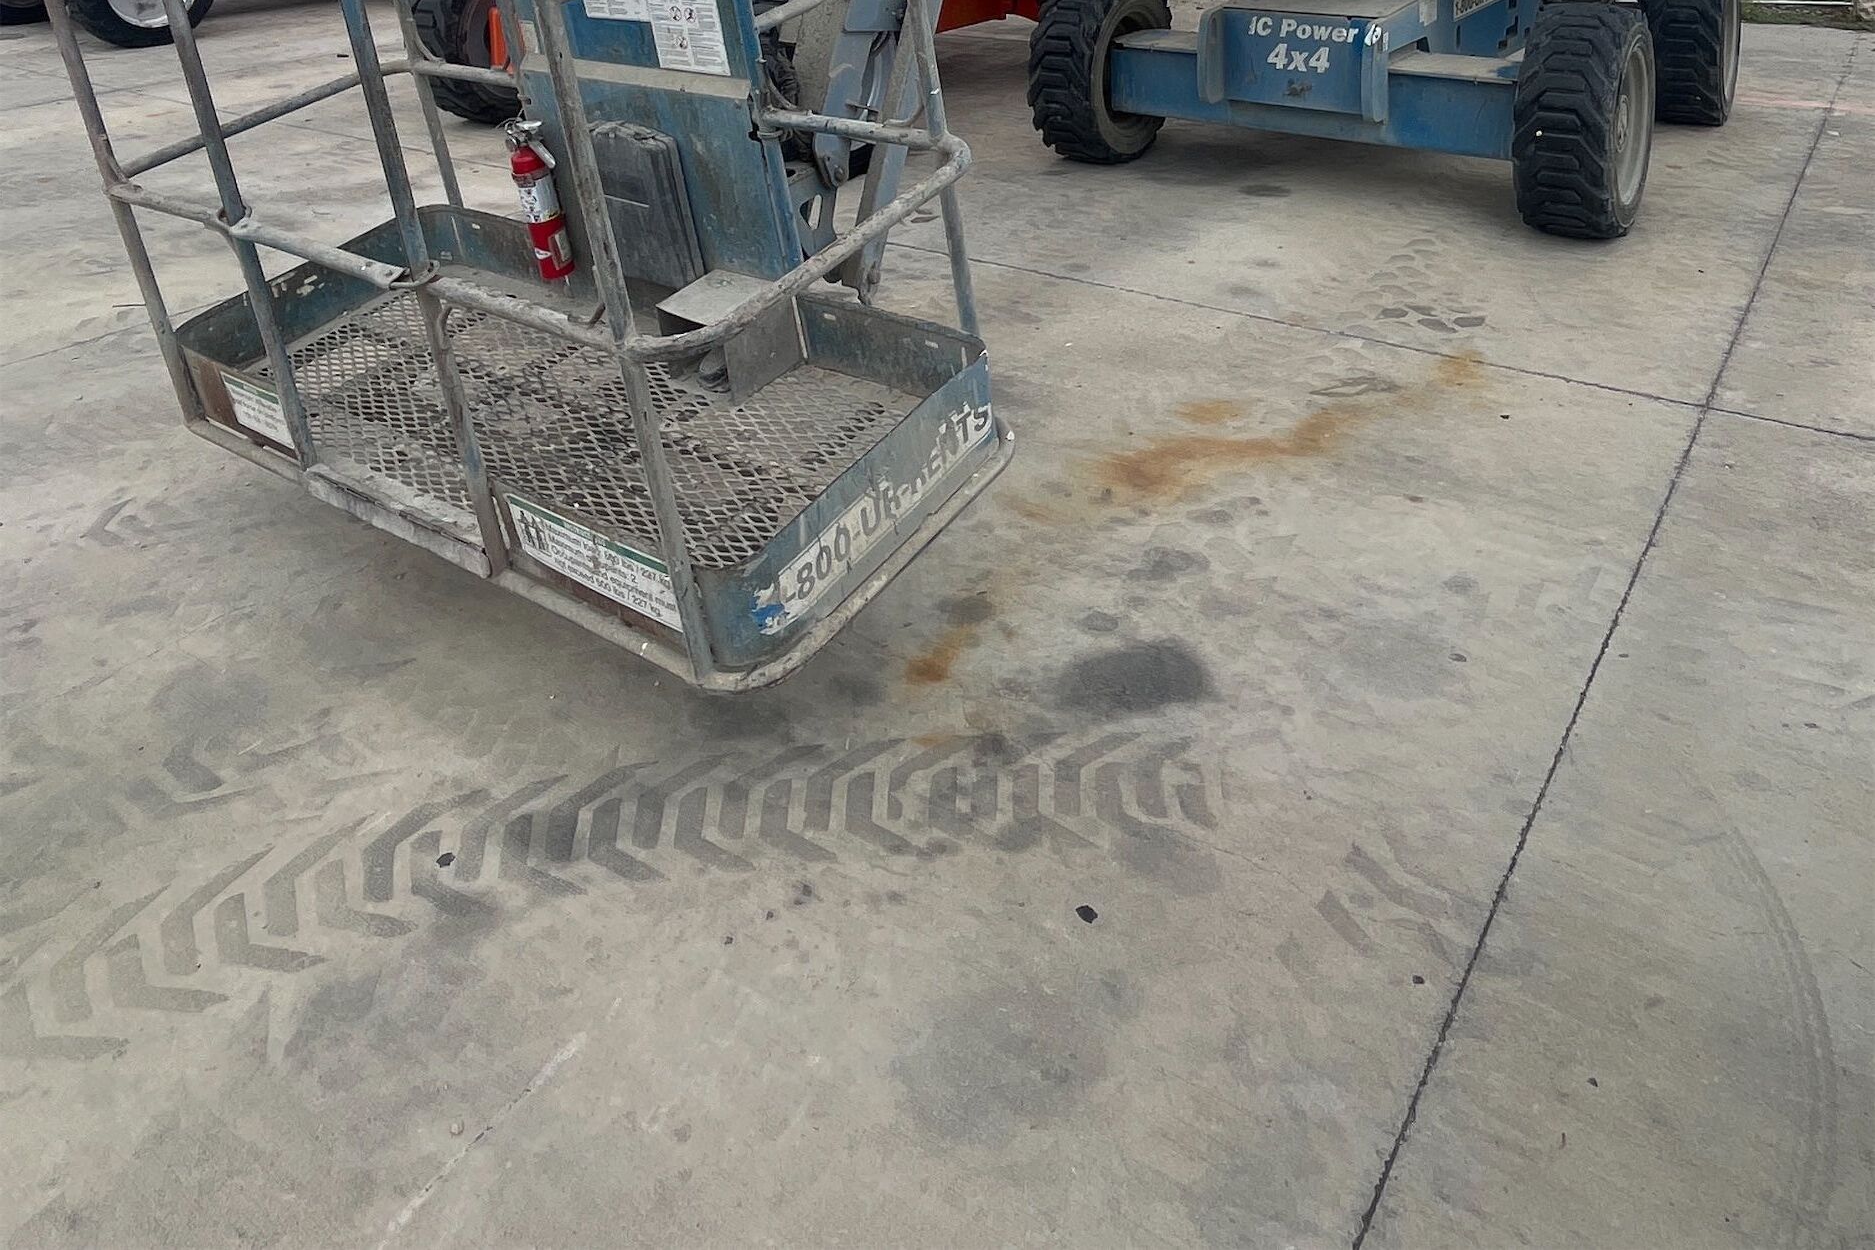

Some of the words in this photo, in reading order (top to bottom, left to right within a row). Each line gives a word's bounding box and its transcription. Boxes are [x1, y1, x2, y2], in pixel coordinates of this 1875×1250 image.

[1280, 18, 1361, 44] Power
[1267, 43, 1331, 74] 4x4
[631, 594, 648, 609] 227
